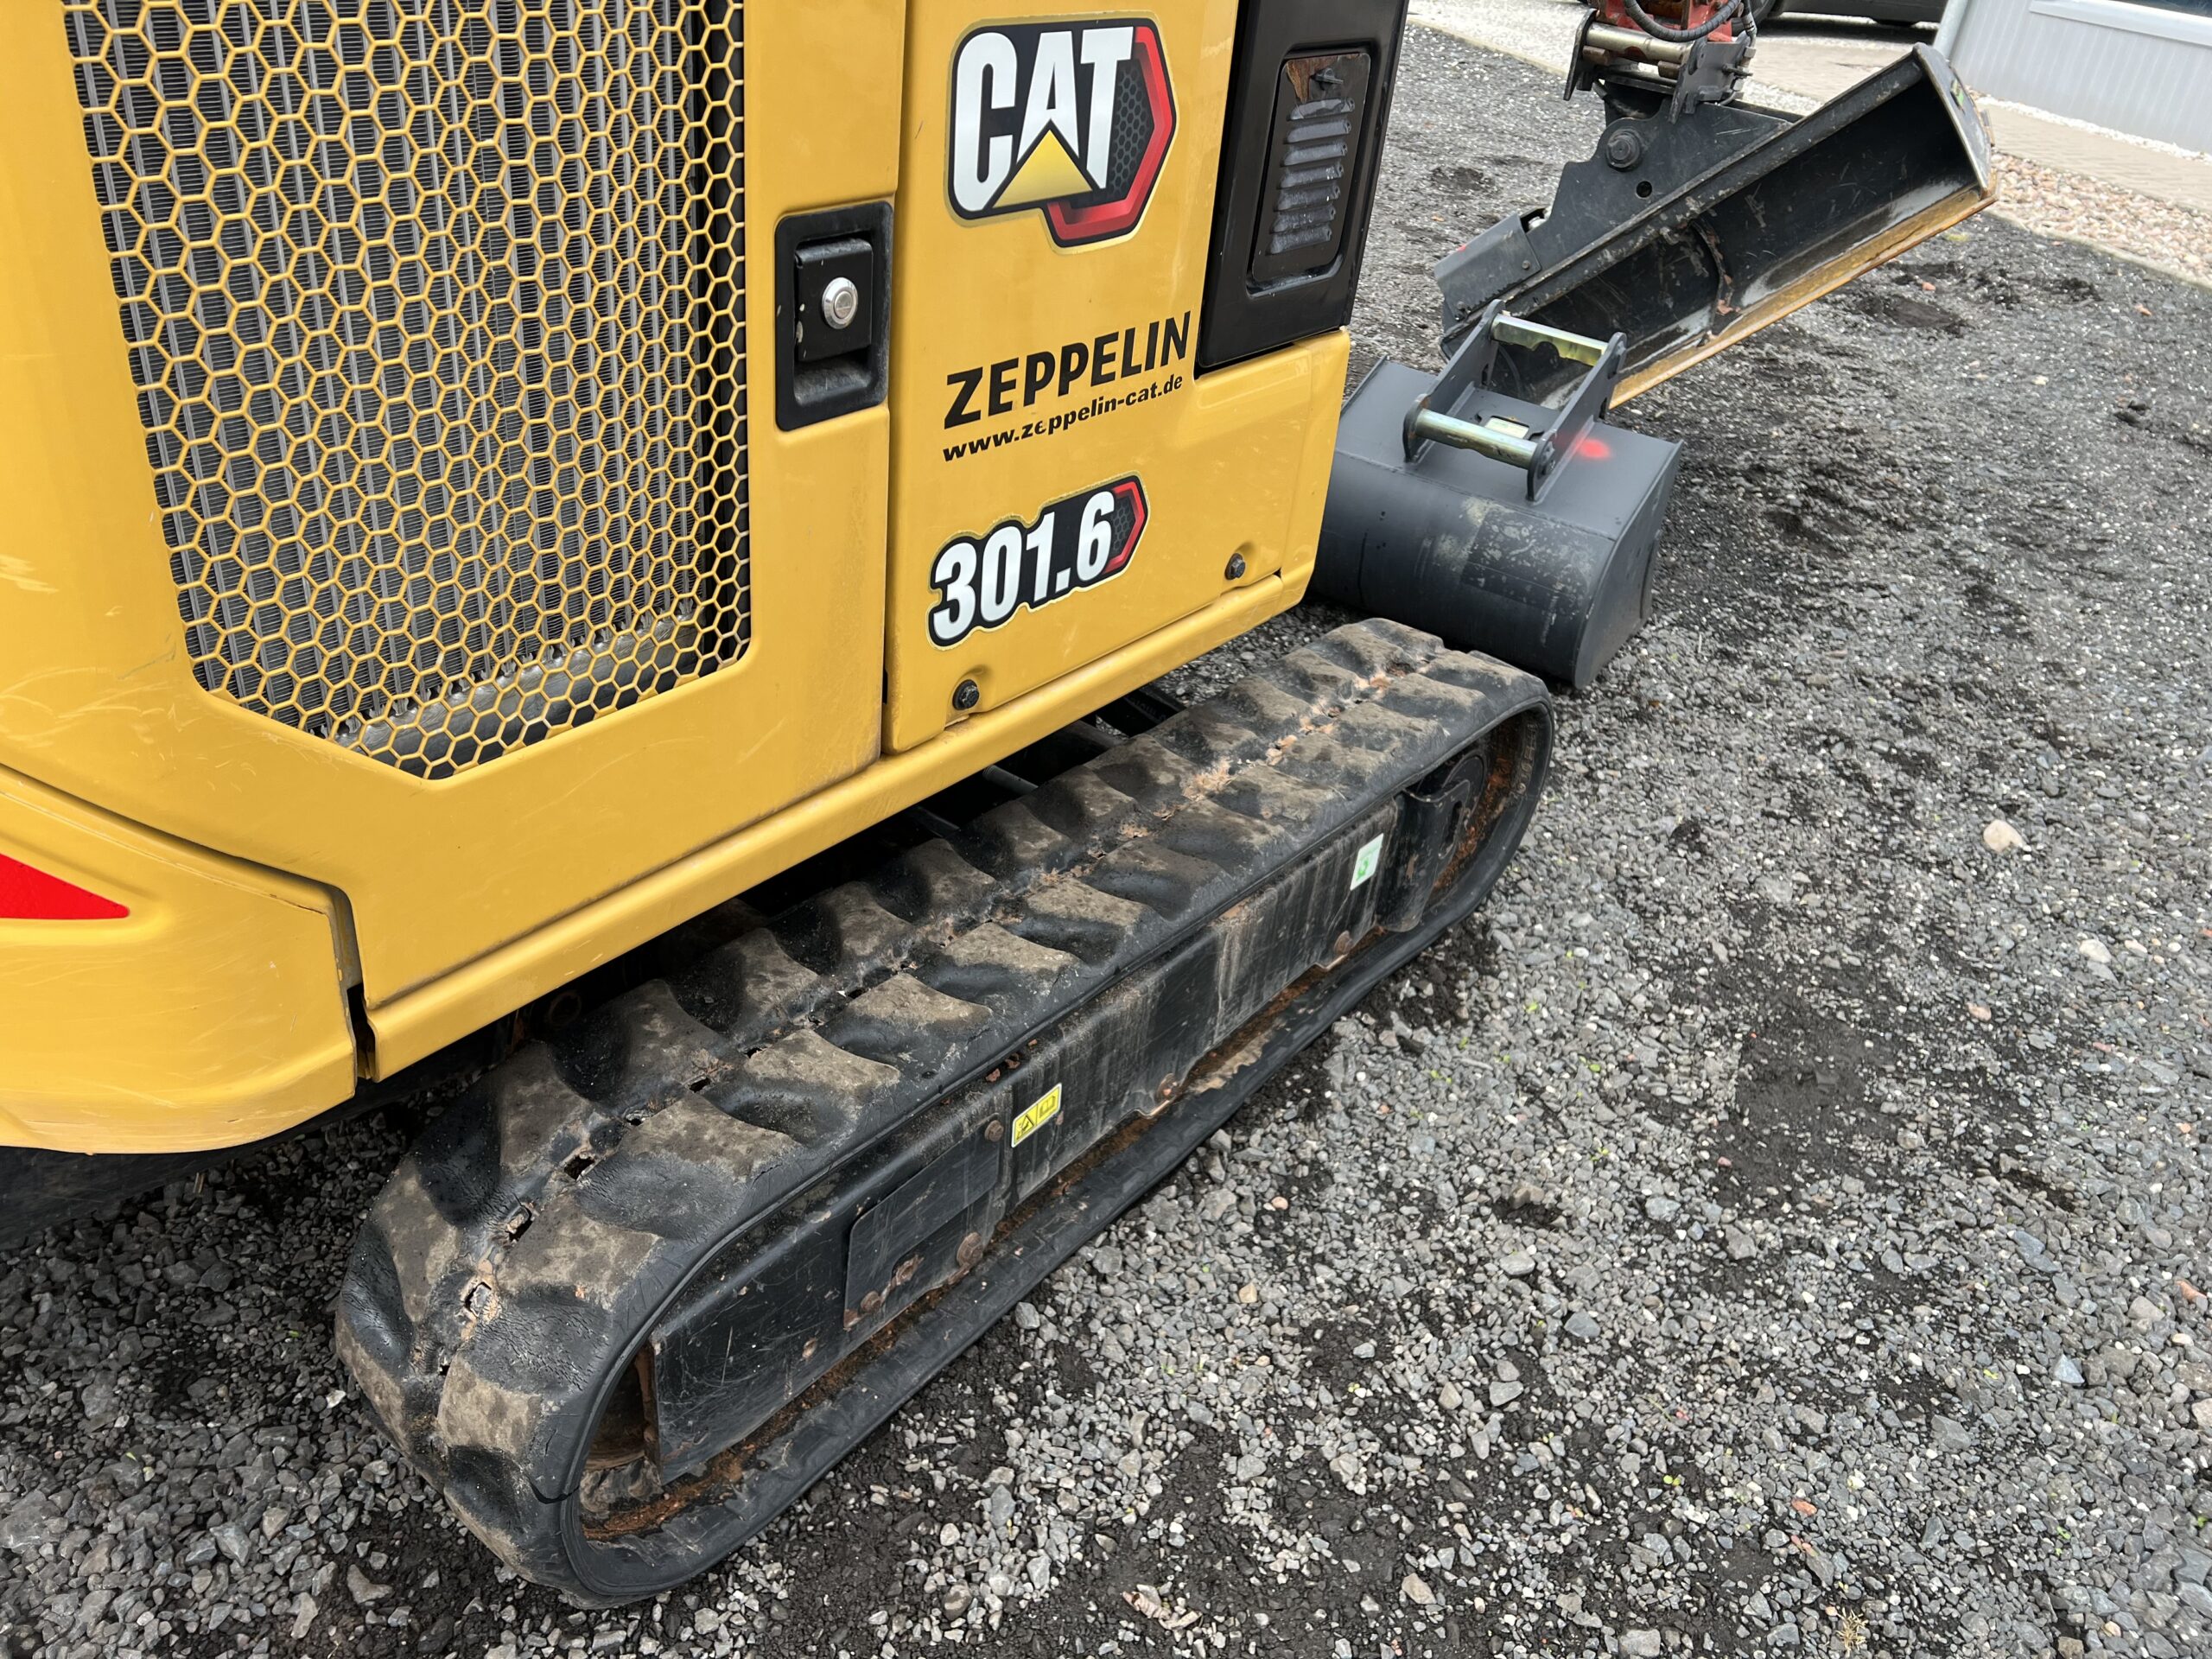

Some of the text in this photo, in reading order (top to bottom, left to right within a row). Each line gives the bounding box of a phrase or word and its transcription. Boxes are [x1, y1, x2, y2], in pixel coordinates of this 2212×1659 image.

[953, 27, 1134, 212] CAT
[943, 373, 1183, 461] www.zeppelin-cat.de
[944, 311, 1191, 429] ZEPPELIN
[933, 491, 1115, 639] 301.6
